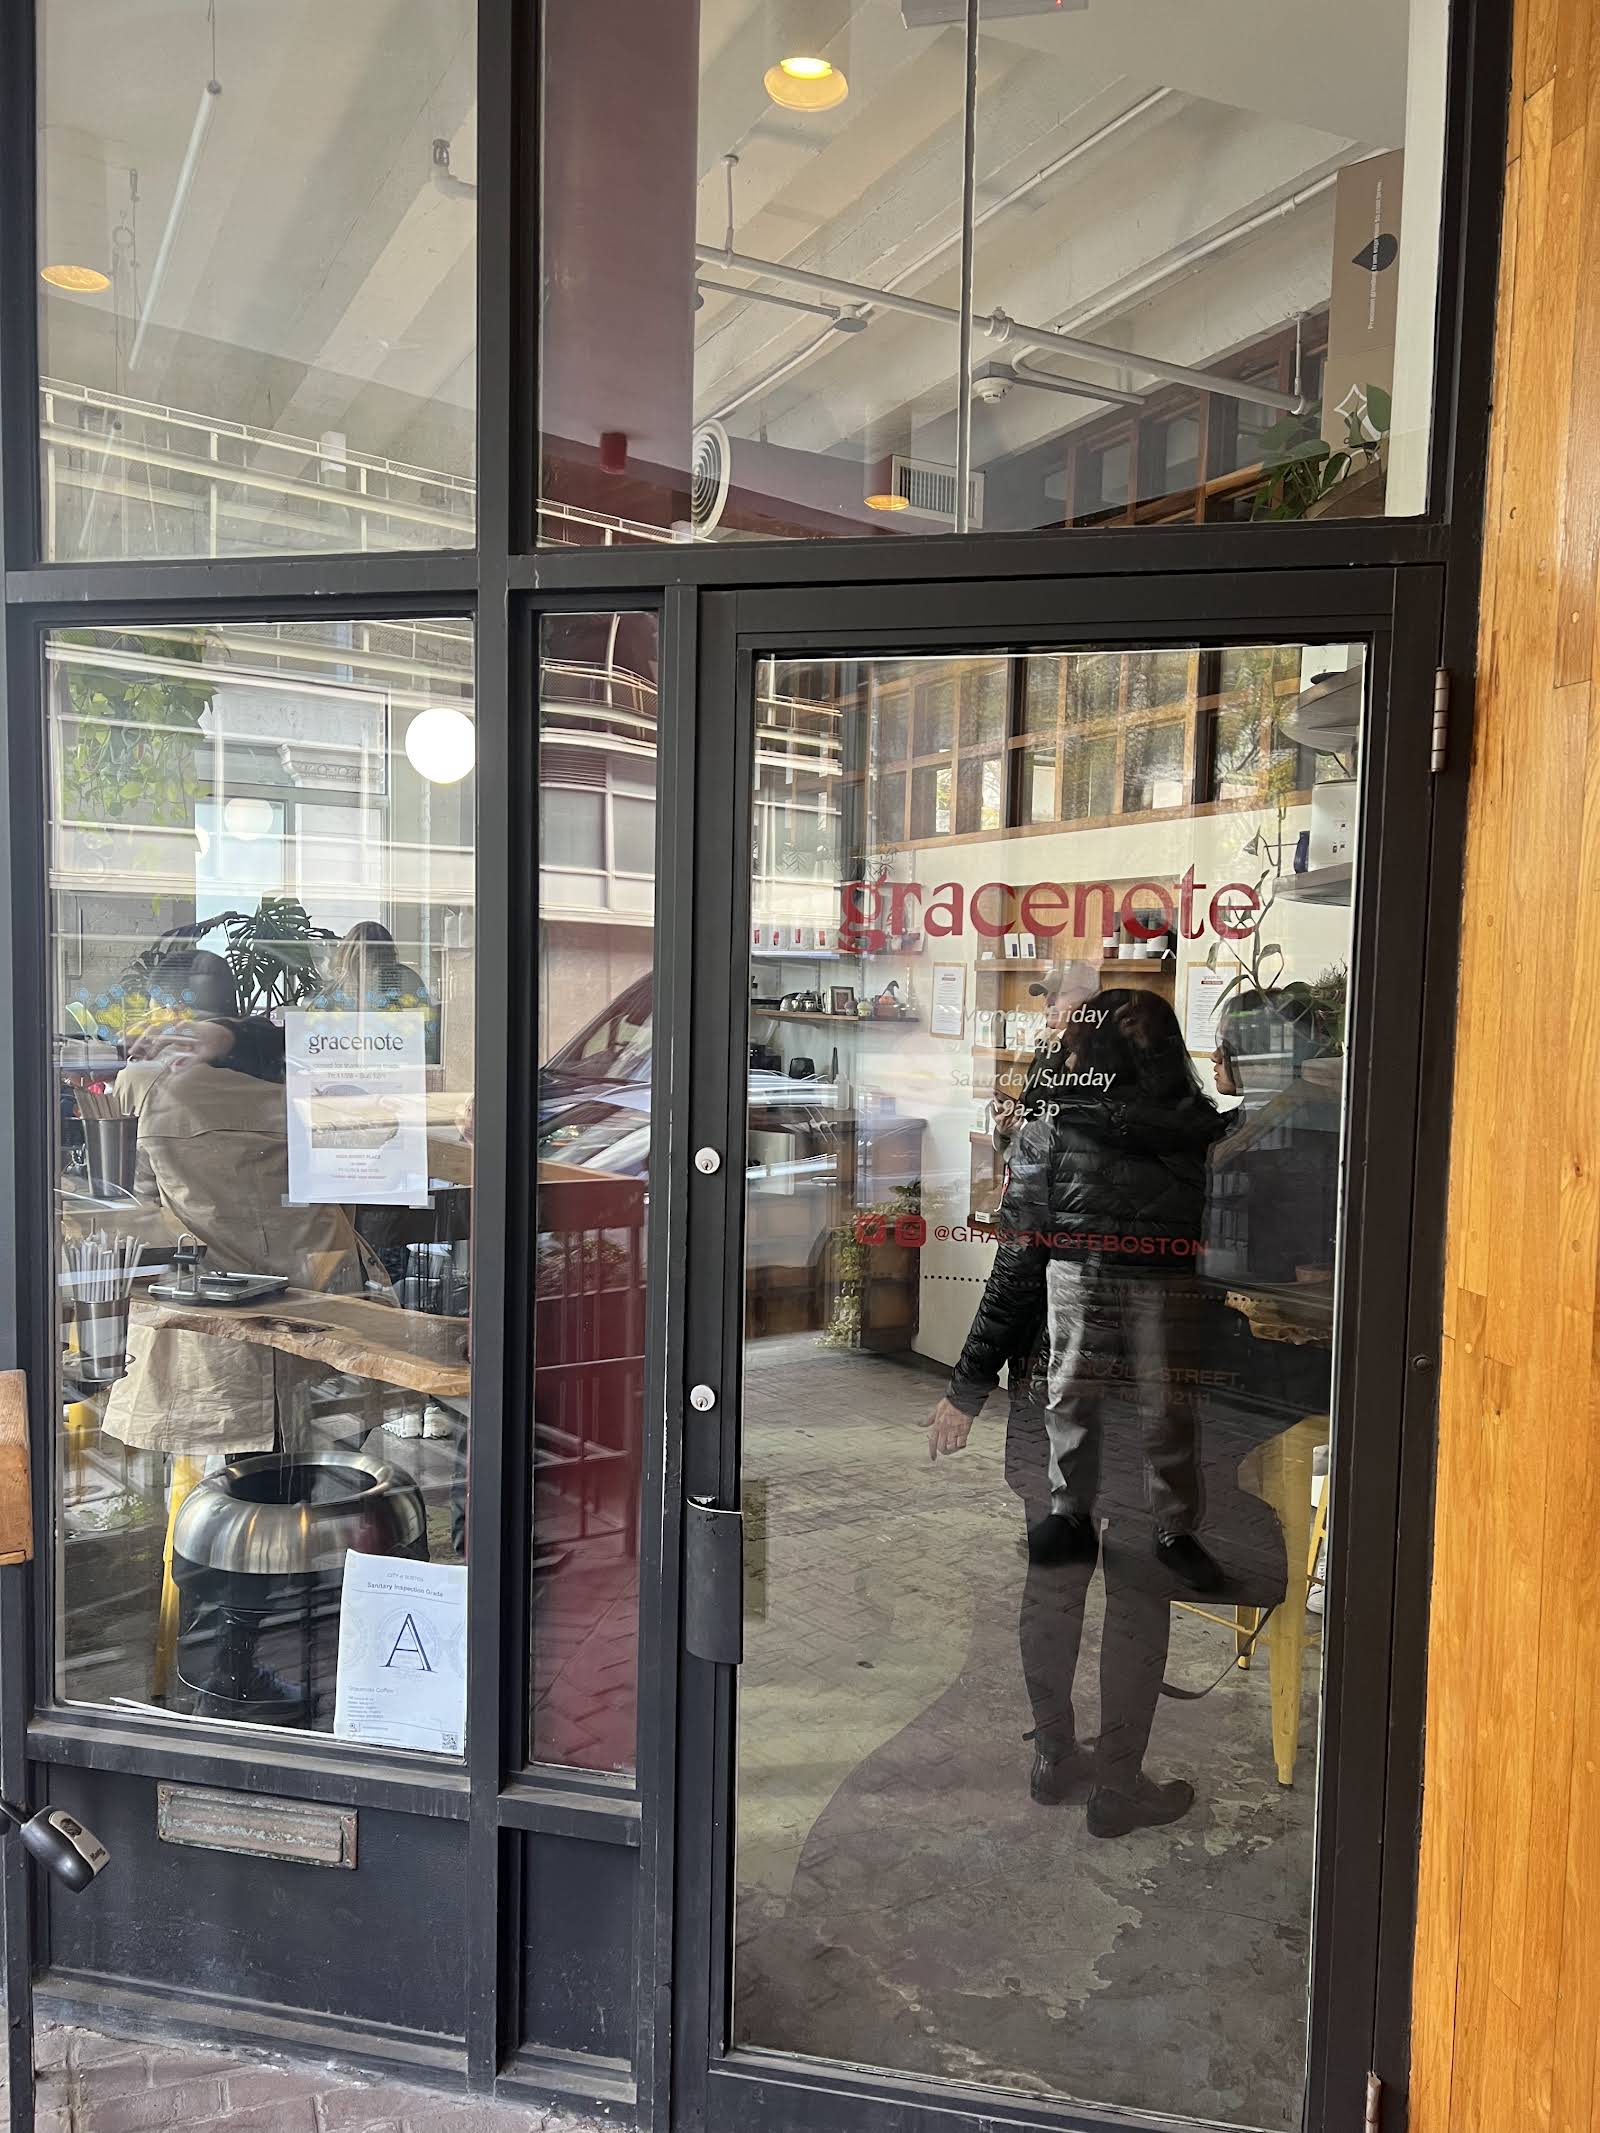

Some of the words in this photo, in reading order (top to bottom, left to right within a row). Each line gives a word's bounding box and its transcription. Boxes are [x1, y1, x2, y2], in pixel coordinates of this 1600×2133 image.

[838, 863, 1260, 955] gracenote
[963, 1004, 1109, 1029] Monday/Friday
[308, 1032, 404, 1054] gracenote
[1002, 1099, 1061, 1123] 9a-3p
[367, 1581, 393, 1590] Sanitary
[394, 1583, 425, 1594] Inspection
[425, 1588, 444, 1598] Grade
[377, 1613, 439, 1674] A
